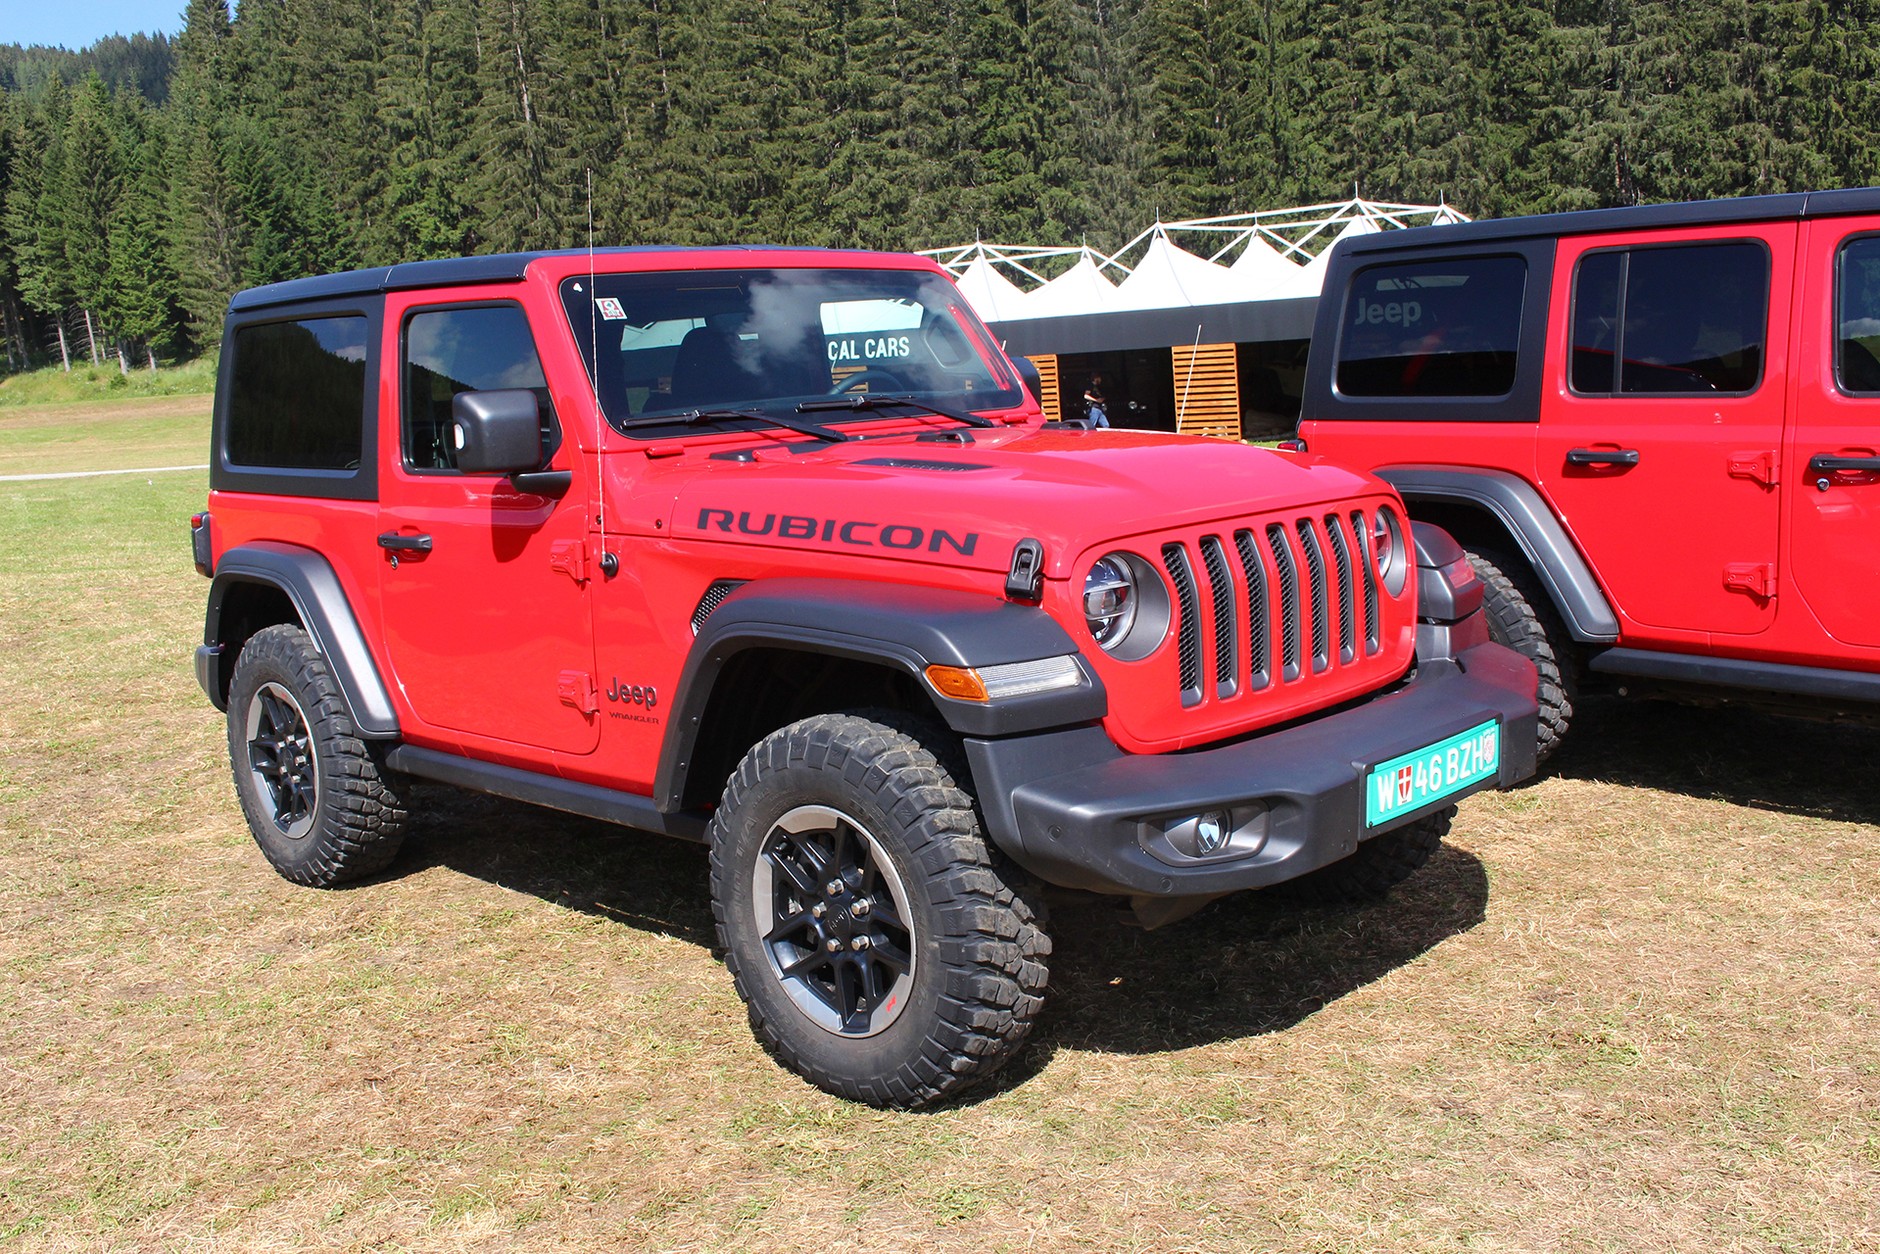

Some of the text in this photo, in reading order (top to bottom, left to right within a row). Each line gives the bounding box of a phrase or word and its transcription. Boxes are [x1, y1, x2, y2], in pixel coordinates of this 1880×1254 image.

[1354, 298, 1422, 327] Jeep
[864, 336, 910, 359] CARS
[697, 508, 979, 556] RUBICON
[606, 676, 657, 711] Jeep
[609, 711, 659, 725] WRANGLER
[1377, 734, 1484, 813] W 46 BZH
